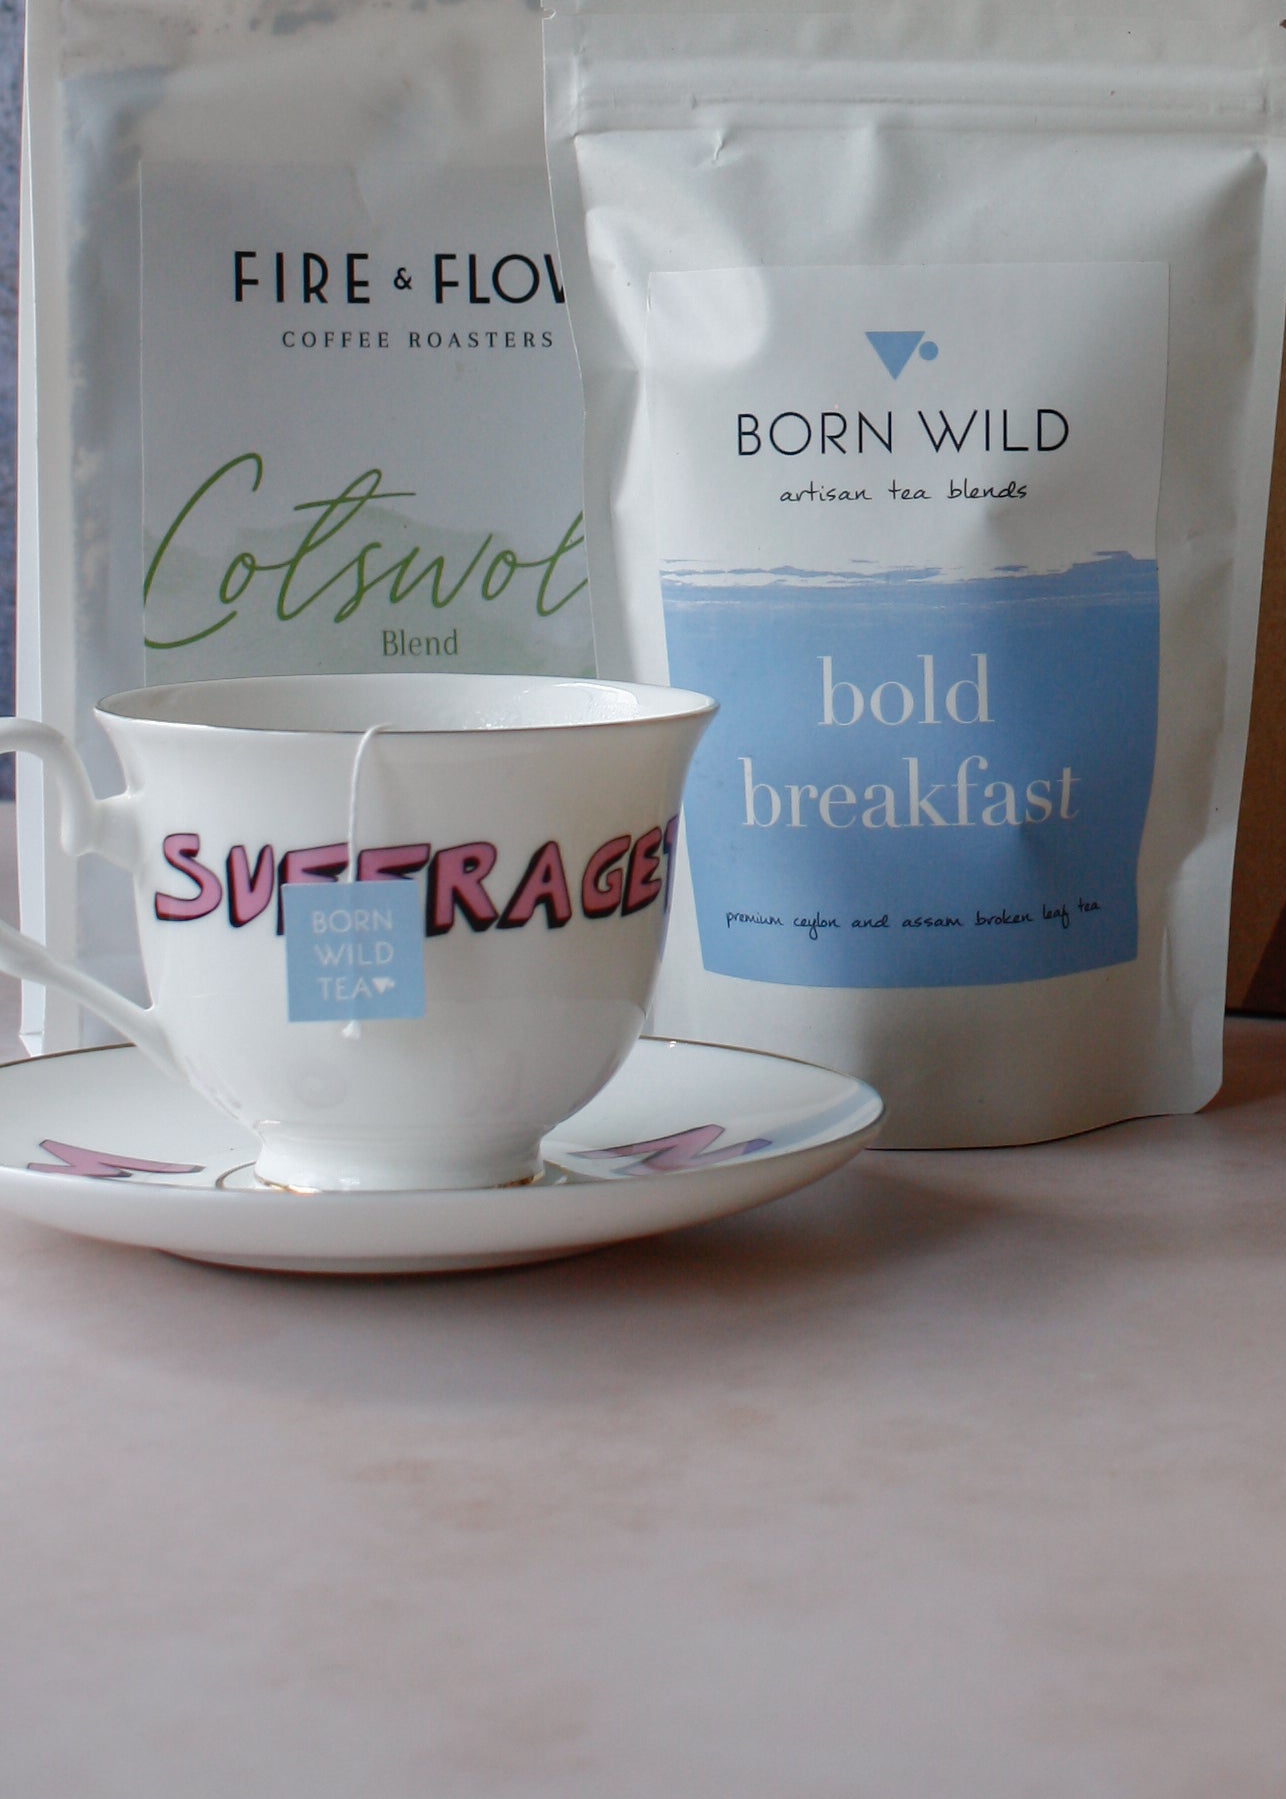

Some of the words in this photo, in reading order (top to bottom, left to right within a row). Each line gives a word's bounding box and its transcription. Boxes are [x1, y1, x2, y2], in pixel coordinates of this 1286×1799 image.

[234, 250, 371, 304] FIRE
[393, 267, 413, 290] &
[282, 330, 390, 349] COFFEE
[408, 331, 554, 349] ROASTERS
[737, 410, 893, 456] BORN
[917, 408, 1070, 453] WILD
[780, 481, 873, 502] artisan
[887, 479, 932, 500] tea
[947, 478, 1028, 500] blends
[381, 629, 459, 657] Blend
[817, 652, 995, 726] bold
[737, 754, 1081, 829] breakfast
[311, 908, 394, 934] BORN
[725, 910, 785, 928] premium
[792, 909, 841, 940] ceylon
[851, 913, 889, 928] and
[901, 916, 964, 928] assam
[975, 908, 1034, 927] broken
[1042, 903, 1069, 929] leaf
[1078, 898, 1102, 913] tea
[313, 941, 395, 969] WILD
[317, 976, 373, 1001] TEA
